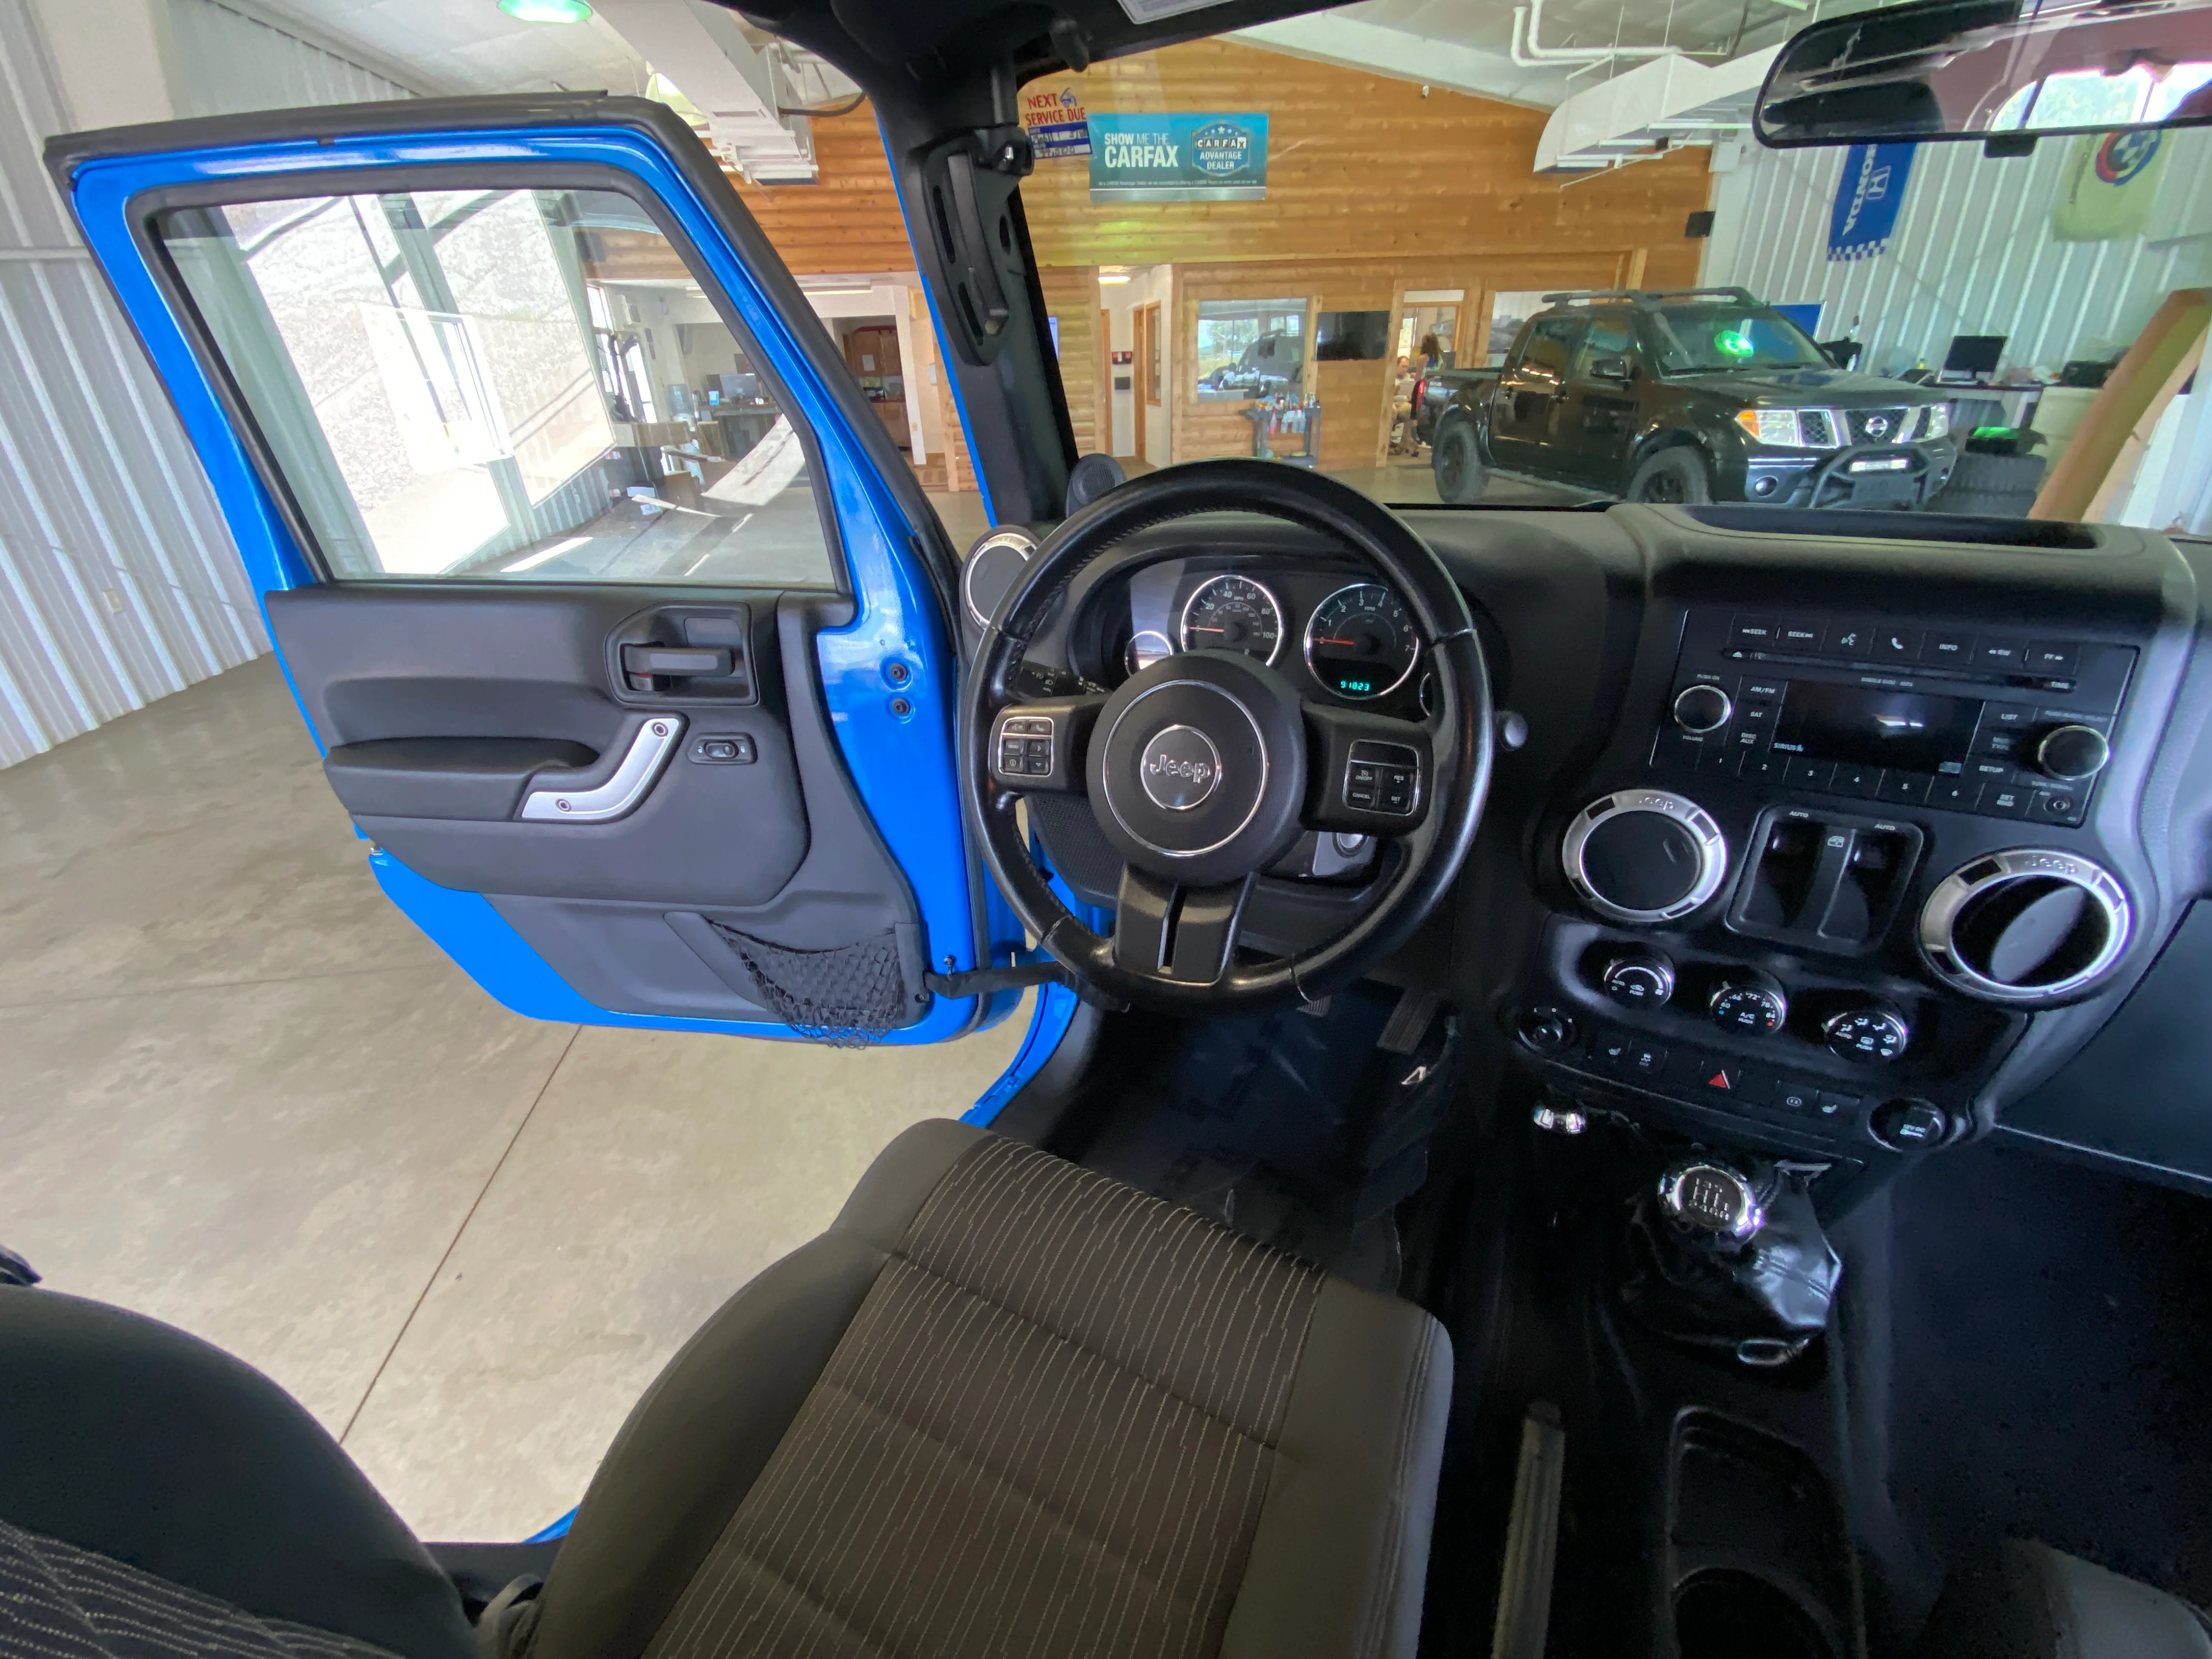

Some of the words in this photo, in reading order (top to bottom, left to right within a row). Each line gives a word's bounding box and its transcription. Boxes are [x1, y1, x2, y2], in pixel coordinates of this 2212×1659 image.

[1027, 93, 1057, 109] NEXT
[1025, 110, 1065, 126] SERVICE
[1067, 107, 1086, 121] DUE
[1104, 133, 1134, 145] SHOW
[1137, 133, 1150, 145] ME
[1153, 132, 1169, 145] THE
[1197, 137, 1246, 149] CARFAX
[1105, 145, 1178, 168] CARFAX
[1200, 151, 1242, 161] ADVANTAGE
[1207, 161, 1234, 170] DEALER
[1150, 754, 1211, 783] Jeep
[1789, 810, 1809, 818] AUTO
[2024, 855, 2079, 875] Jeep
